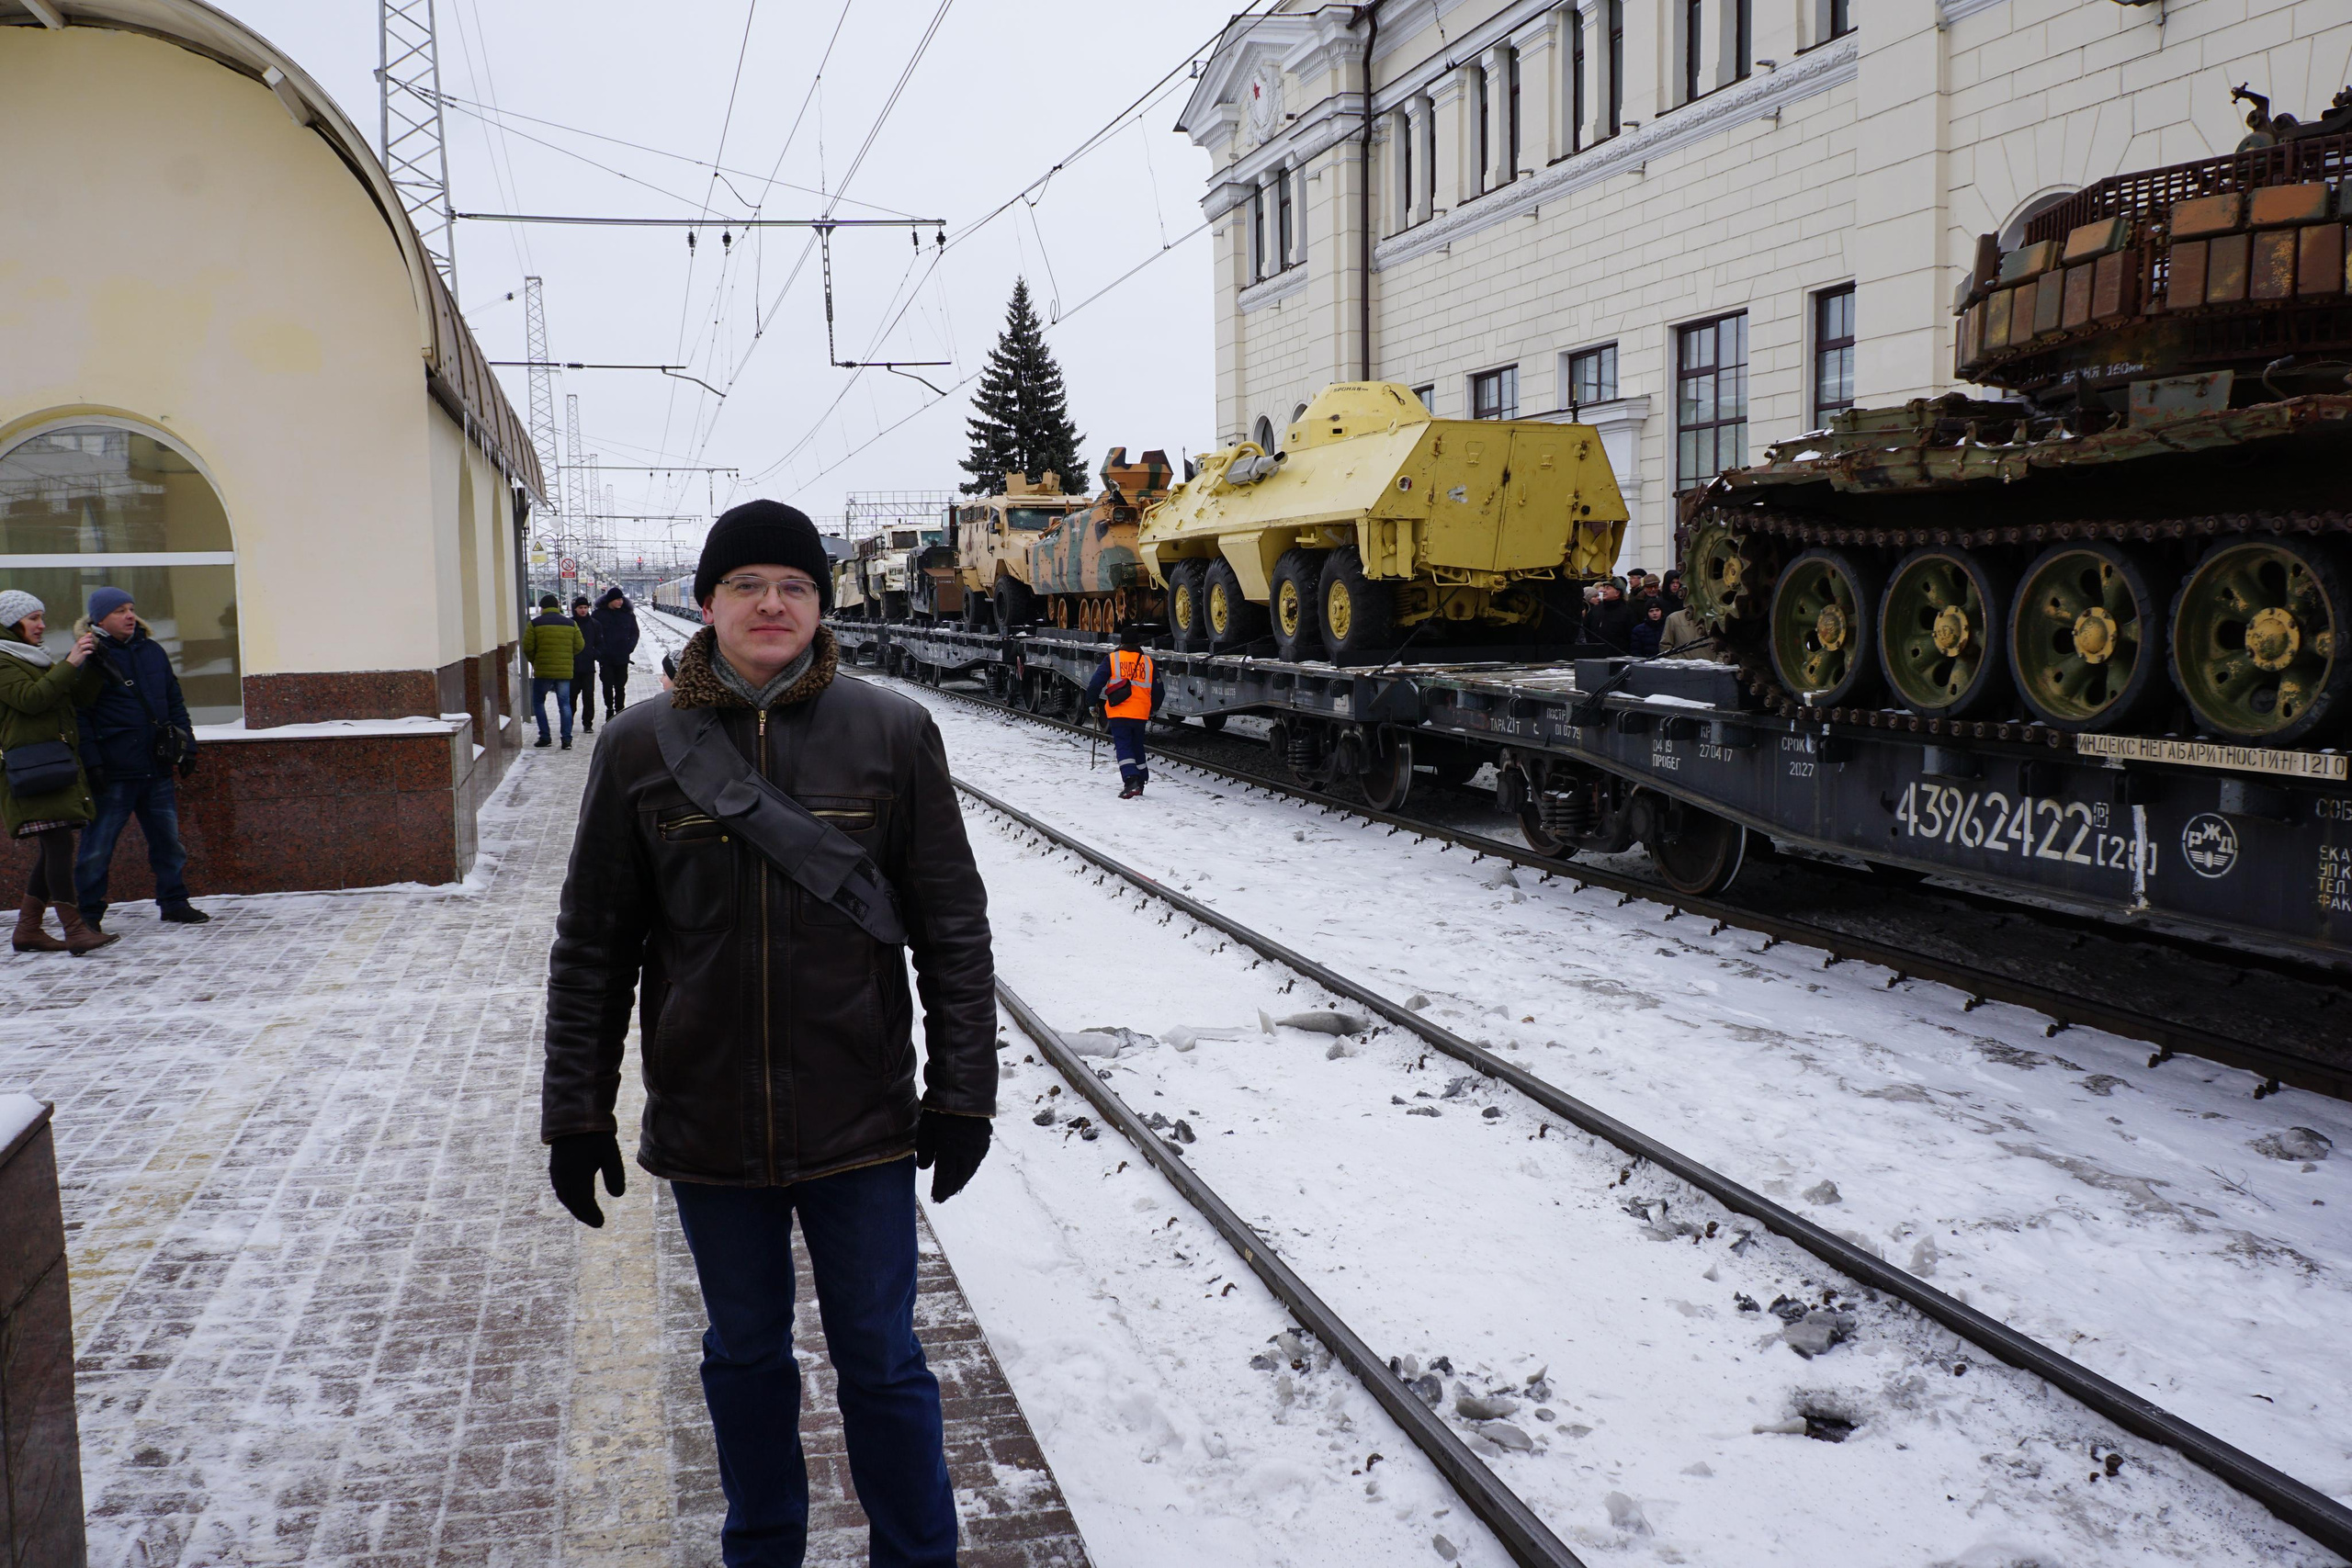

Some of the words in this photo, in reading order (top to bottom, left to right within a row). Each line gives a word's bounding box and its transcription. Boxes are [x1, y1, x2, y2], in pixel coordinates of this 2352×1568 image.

[2062, 366, 2100, 385] БРНЯ
[1490, 716, 1506, 733] ТАРА
[1781, 736, 1805, 753] СРОК
[2078, 735, 2135, 755] ИНДЕКС
[1652, 753, 1680, 771] ПРОБЕГ
[1789, 761, 1815, 777] 2027
[1896, 782, 2093, 865] 43962422
[2188, 822, 2234, 854] РЖД
[2319, 845, 2352, 863] ЕКА
